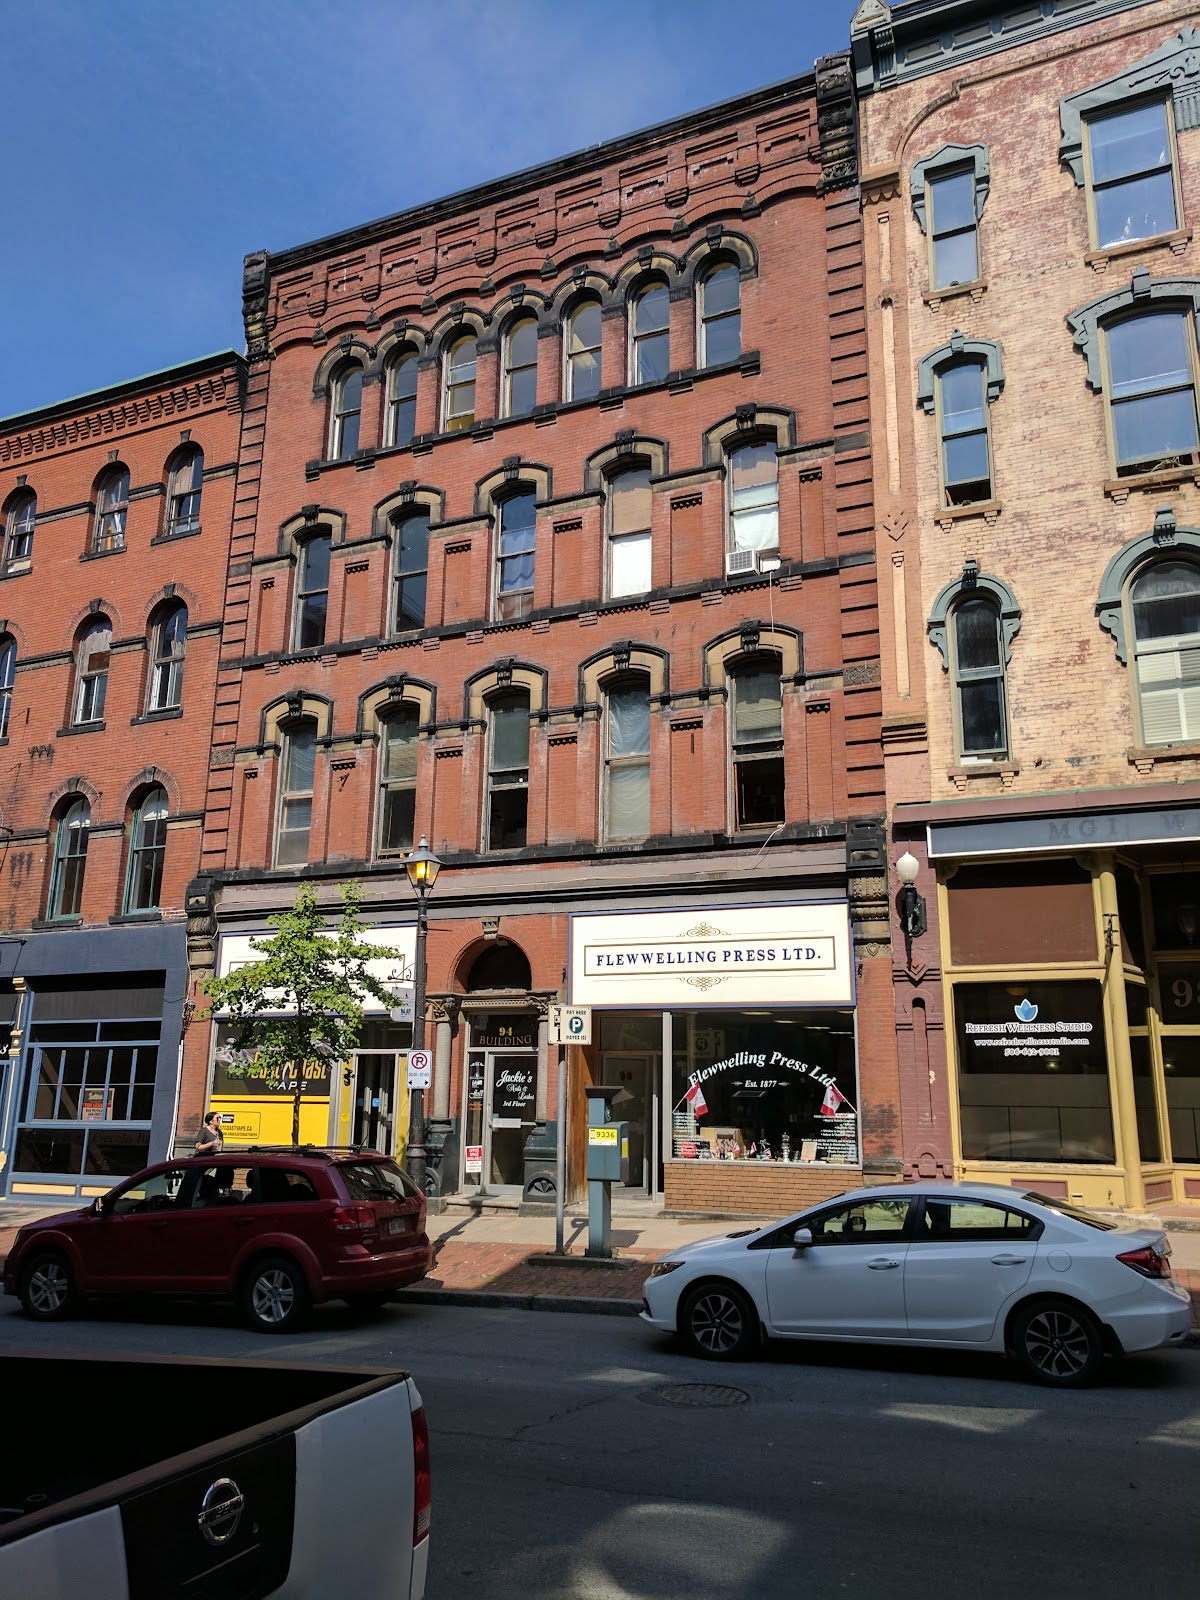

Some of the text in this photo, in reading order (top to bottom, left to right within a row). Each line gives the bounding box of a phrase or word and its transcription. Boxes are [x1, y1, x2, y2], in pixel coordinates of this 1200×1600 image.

[596, 947, 821, 966] FLEWWELLING PRESS LTD.
[1172, 978, 1200, 1008] 9
[499, 1026, 513, 1036] 94
[965, 1021, 1093, 1034] REFRESH WELLNESS STUDIO
[480, 1035, 532, 1047] BUILDING
[687, 1051, 767, 1088] Flewwelling
[769, 1051, 809, 1073] Press
[496, 1070, 533, 1087] Jackie's
[744, 1080, 777, 1088] Est. 1877
[268, 1081, 308, 1092] APE
[596, 1130, 615, 1138] 9336
[204, 1499, 241, 1523] NISSAN
